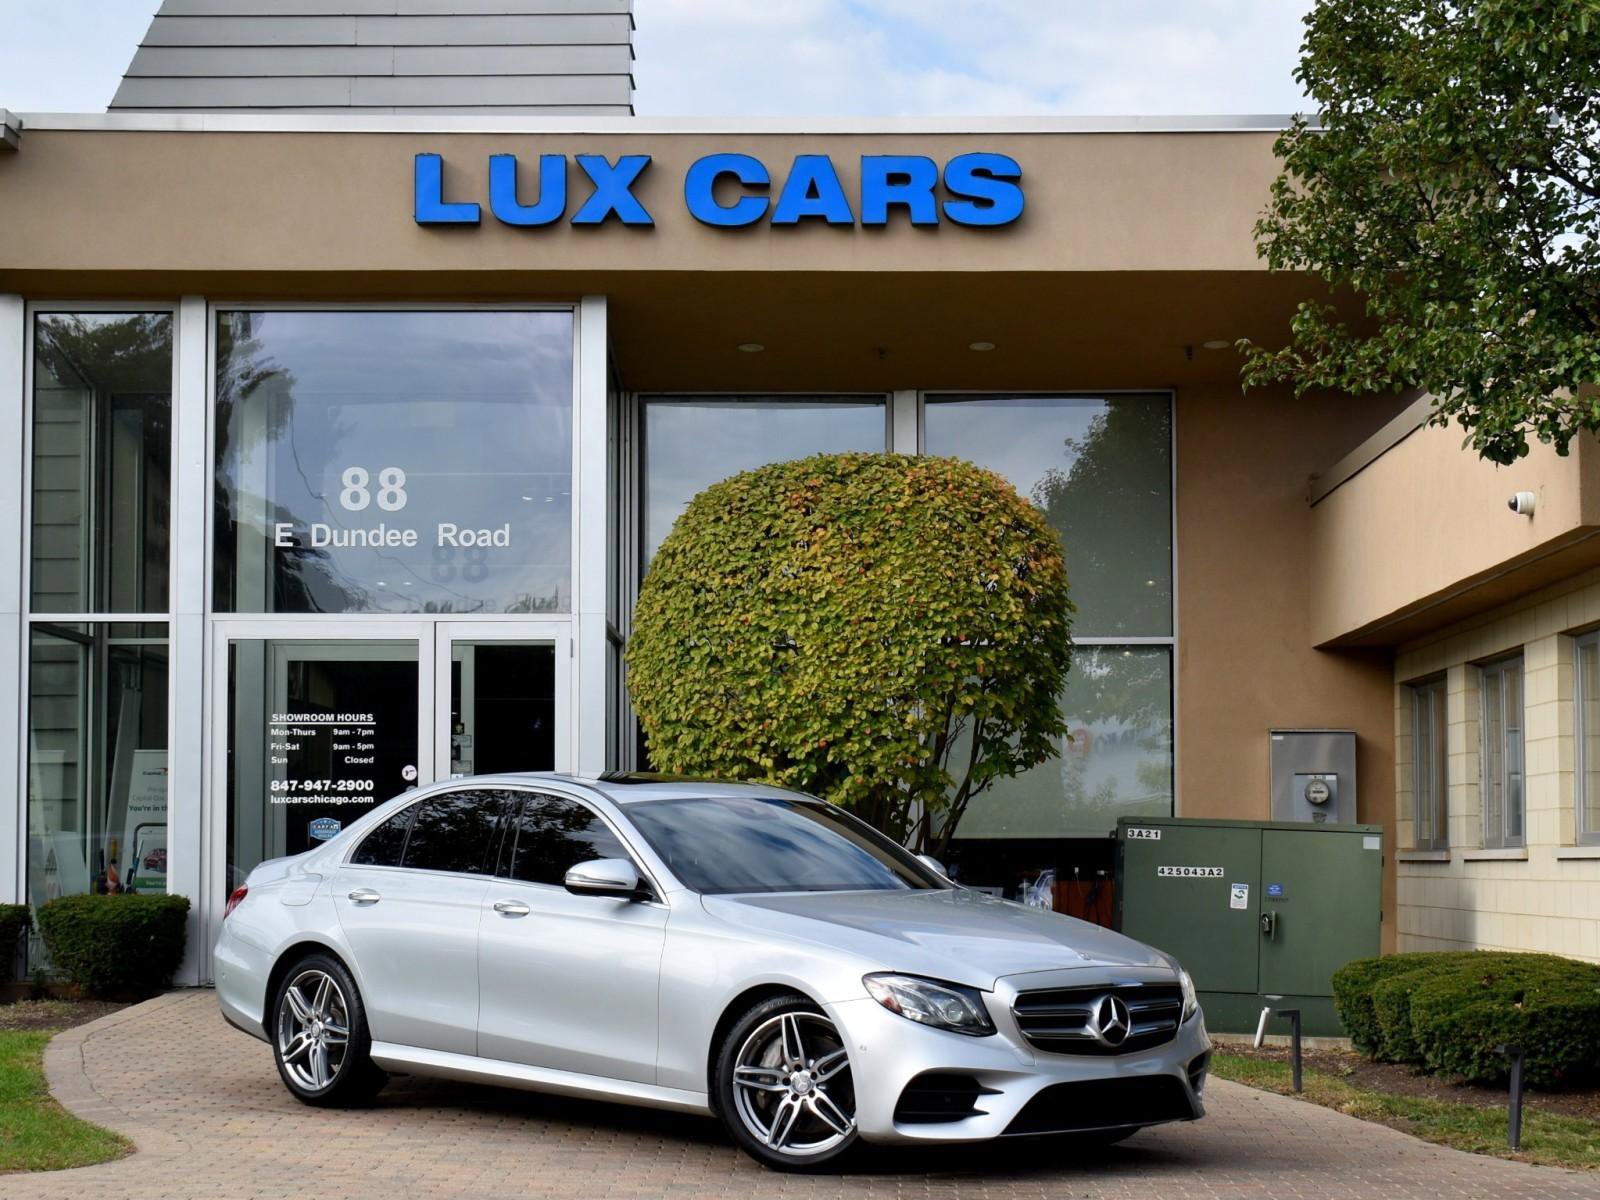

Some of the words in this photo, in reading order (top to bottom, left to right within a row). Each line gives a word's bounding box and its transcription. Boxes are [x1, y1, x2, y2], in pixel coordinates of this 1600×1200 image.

[413, 153, 655, 227] LUX
[684, 152, 1025, 229] CARS
[339, 466, 408, 512] 88
[274, 523, 294, 547] E
[311, 523, 418, 547] Dundee
[437, 523, 510, 547] Road
[271, 713, 335, 722] SHOWROOM
[337, 713, 374, 722] HOURS
[270, 728, 316, 736] Mon-Thurs
[357, 728, 374, 736] 7pm
[270, 742, 300, 751] Fri-Sat
[357, 742, 374, 750] 5pm
[271, 756, 288, 764] Sun
[344, 756, 374, 764] Closed
[270, 780, 374, 791] 847-947-2900
[270, 795, 374, 805] luxcarschicago.com
[152, 804, 160, 812] in
[1128, 829, 1159, 839] 3A21
[1158, 867, 1223, 877] 425043A2
